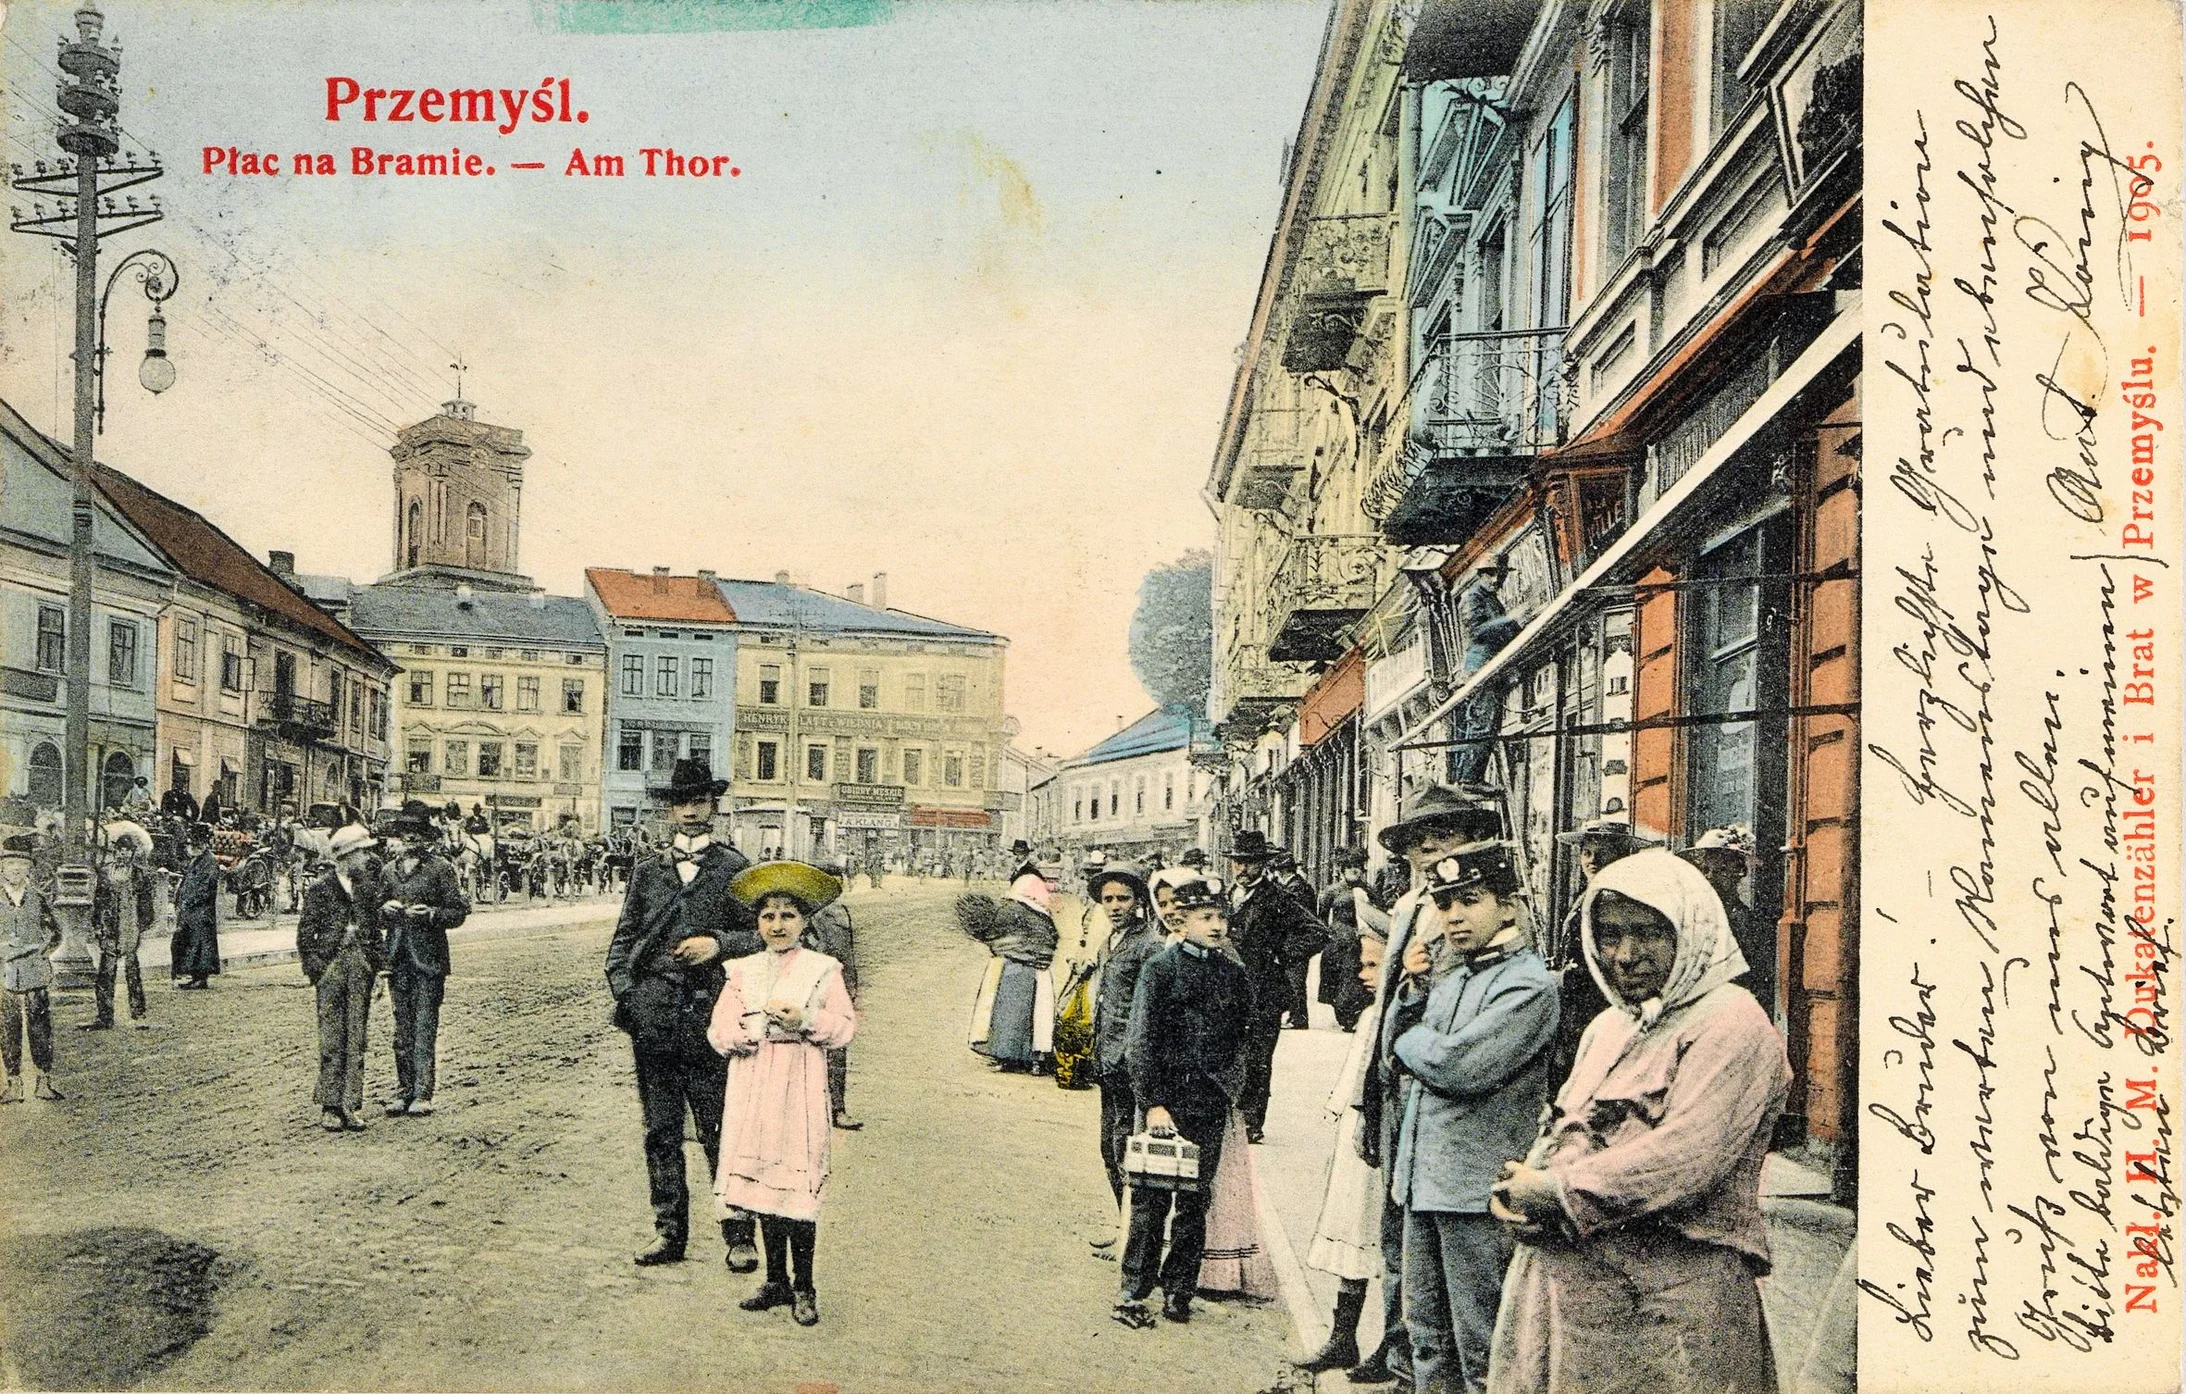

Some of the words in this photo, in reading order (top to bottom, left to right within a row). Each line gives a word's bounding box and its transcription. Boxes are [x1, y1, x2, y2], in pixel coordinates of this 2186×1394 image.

[743, 713, 787, 725] HENRYK
[2037, 1045, 2064, 1183] von
[1855, 1169, 1937, 1342] Lieber
